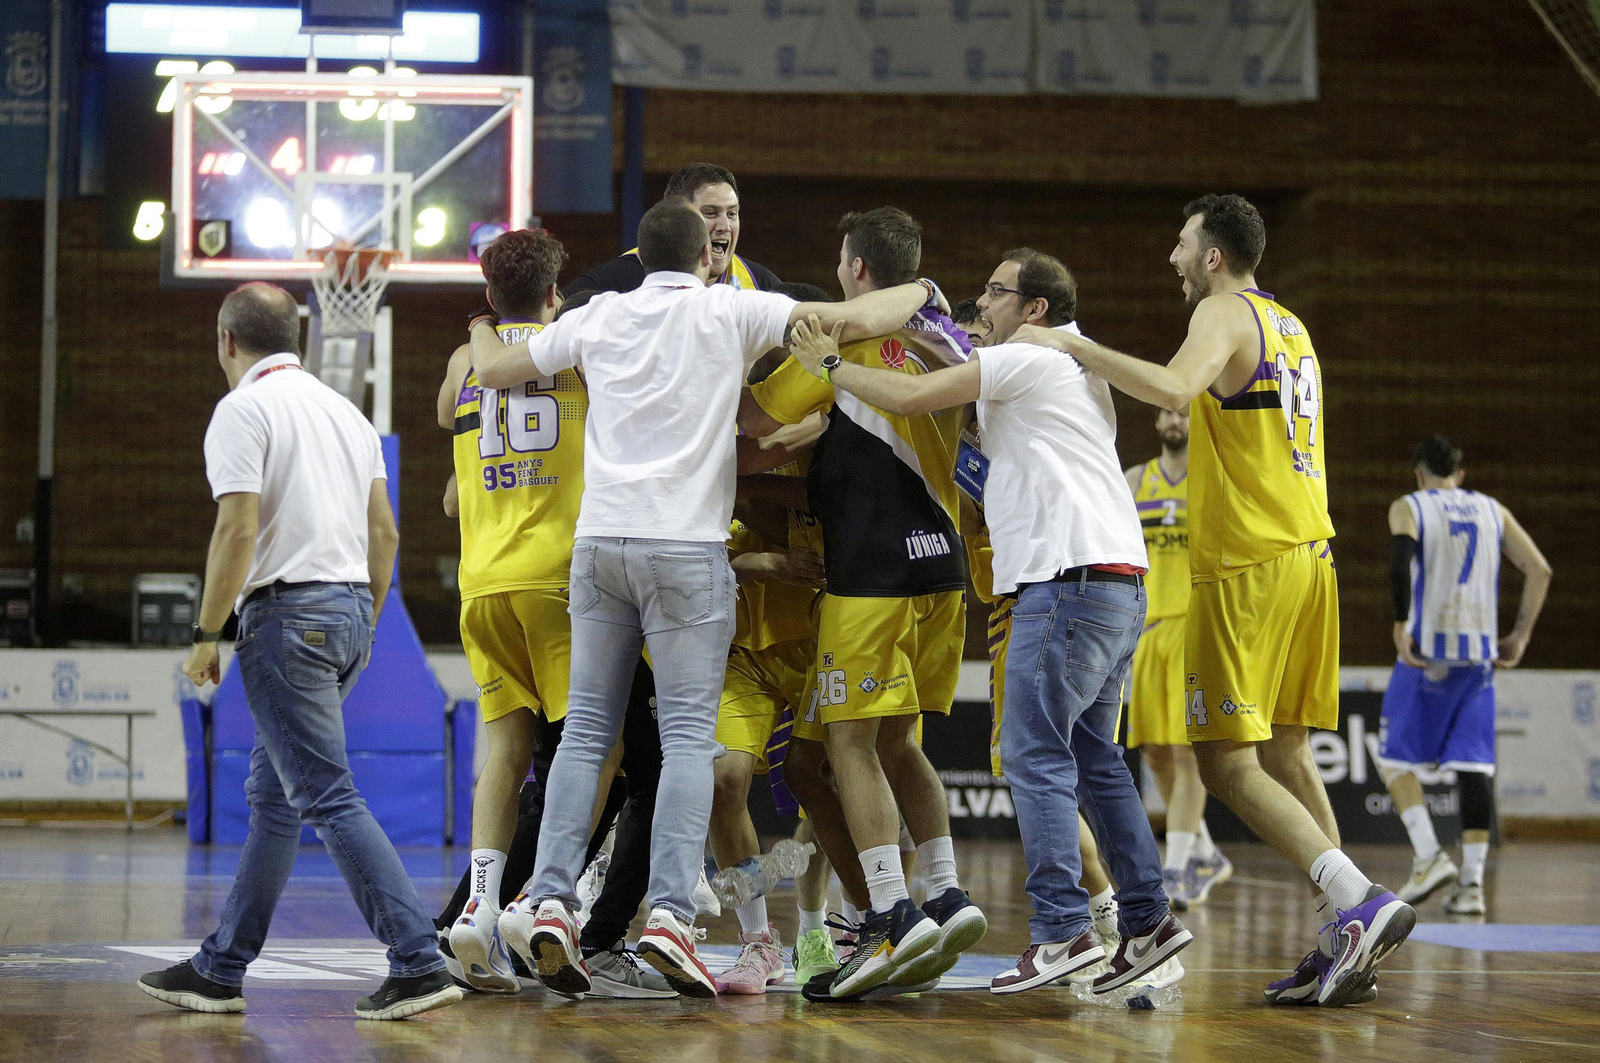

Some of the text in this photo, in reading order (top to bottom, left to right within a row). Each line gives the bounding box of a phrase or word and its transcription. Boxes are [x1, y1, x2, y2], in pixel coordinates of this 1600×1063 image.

[270, 136, 303, 175] 4
[414, 206, 447, 247] 3
[478, 372, 560, 460] 16
[1275, 351, 1320, 447] 14
[483, 459, 543, 492] 95 ANYS
[518, 468, 539, 479] FENT
[518, 476, 560, 488] BASQUET
[1448, 520, 1478, 585] 7
[818, 669, 848, 707] 26
[1185, 689, 1209, 726] 14
[476, 869, 487, 894] SOCKS
